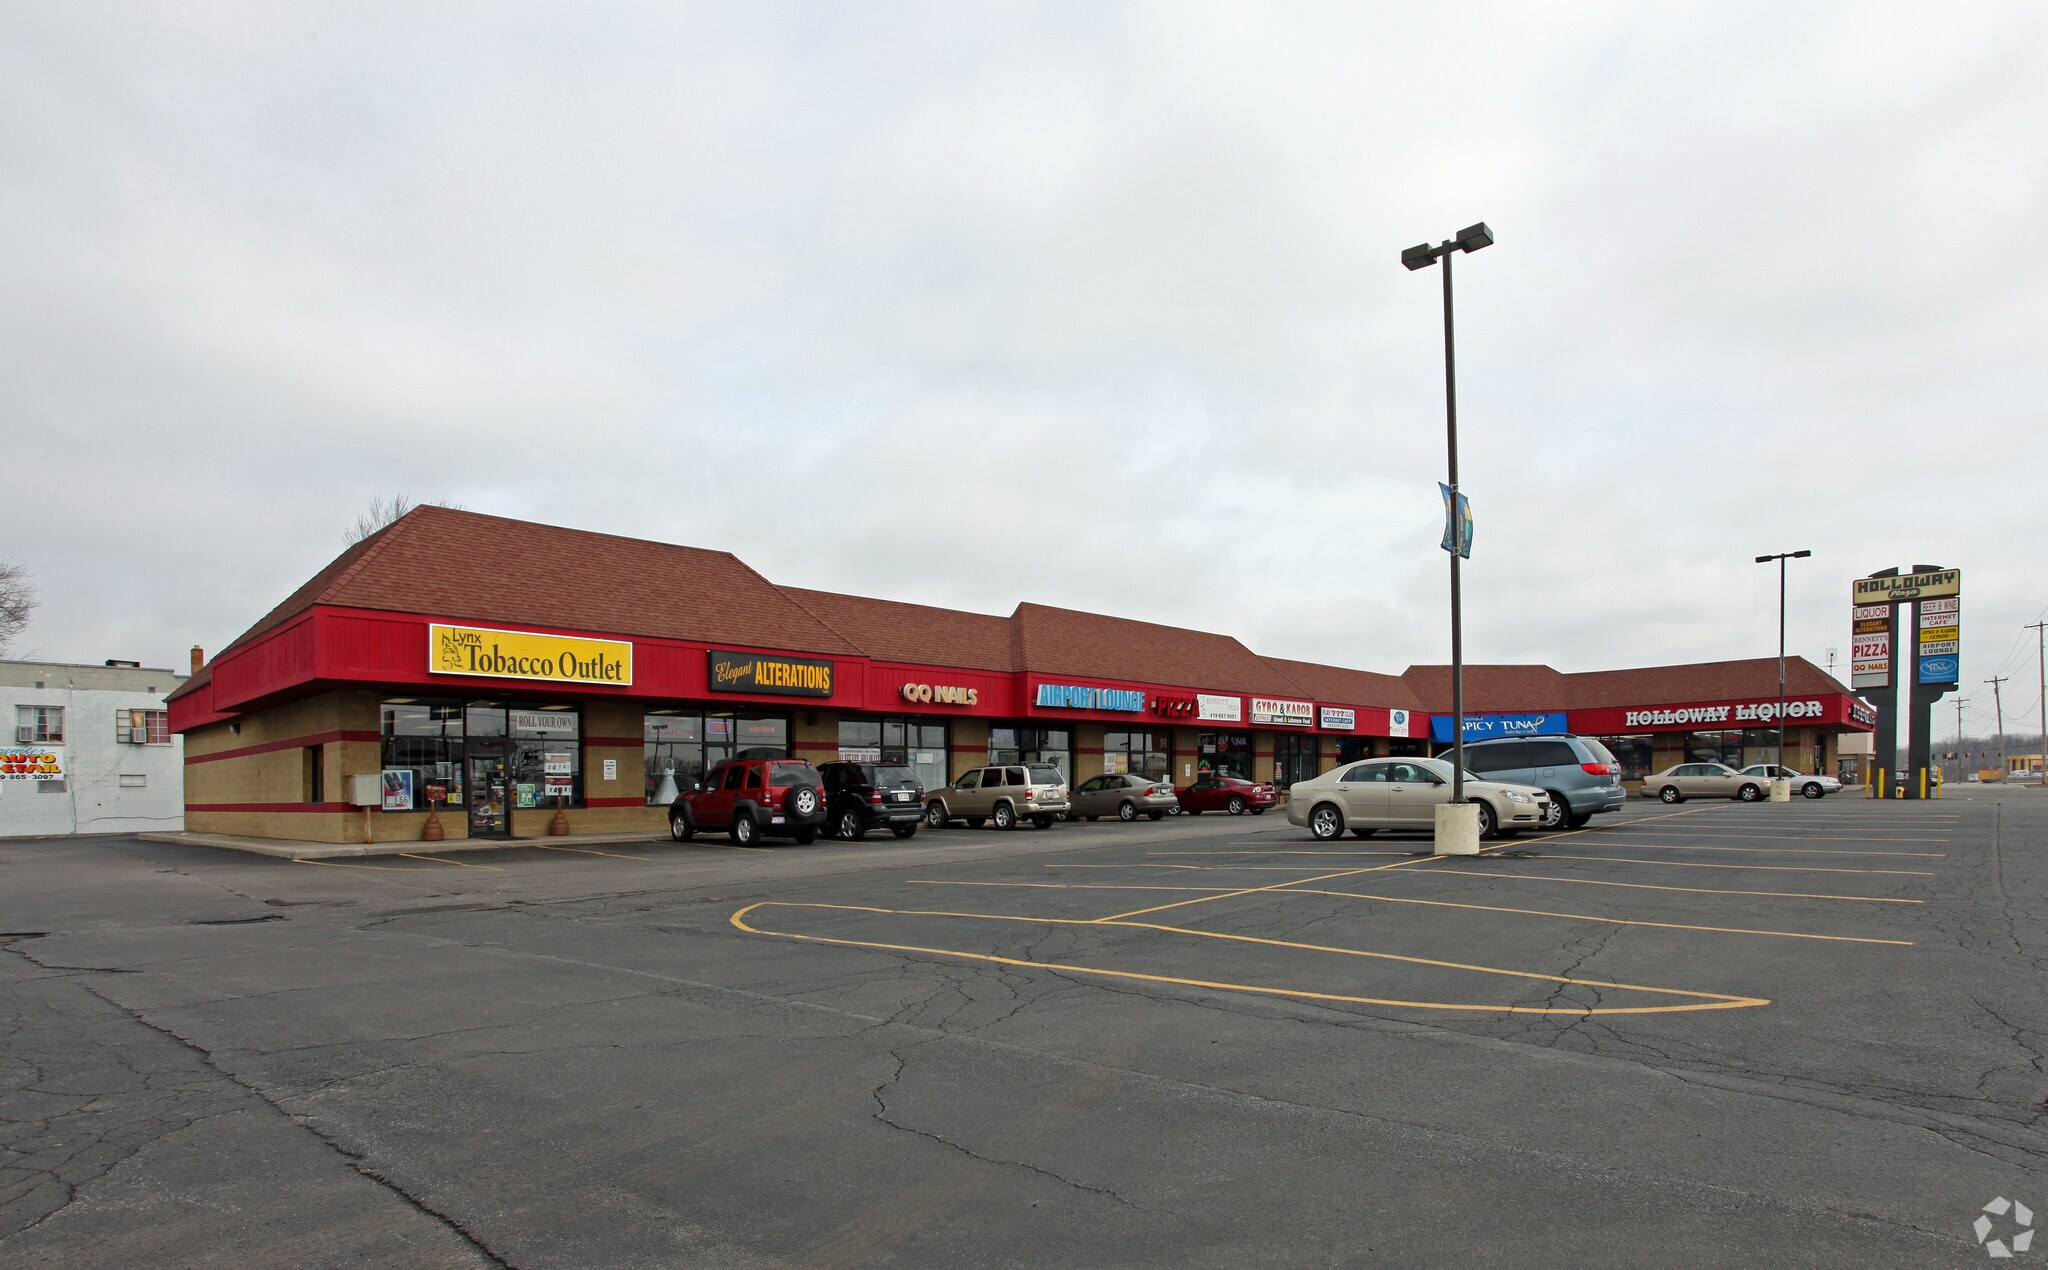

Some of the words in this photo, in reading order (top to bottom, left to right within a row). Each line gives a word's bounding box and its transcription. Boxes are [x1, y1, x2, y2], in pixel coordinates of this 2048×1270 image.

[1858, 572, 1955, 593] HOLLOWAY
[1890, 588, 1918, 597] Plaza
[1856, 607, 1887, 618] LIQUOR
[1923, 602, 1936, 612] BEER
[452, 627, 481, 646] Lynx
[1854, 635, 1888, 643] BENNETT'S
[1854, 644, 1887, 657] PIZZA
[1923, 641, 1956, 649] AIRPORT
[464, 644, 553, 676] Tobacco
[559, 651, 622, 681] Outlet
[715, 661, 753, 684] Elegant
[755, 661, 830, 689] ALTERATIONS
[903, 683, 932, 703] QQ
[934, 685, 977, 705] NAILS
[1036, 684, 1096, 709] AIRPORT
[1096, 688, 1145, 712] LOUNGE
[1156, 696, 1199, 718] PIZZA
[1256, 701, 1277, 713] GYRO
[1280, 703, 1285, 715] &
[1286, 703, 1310, 715] KABOB
[1626, 706, 1730, 726] HOLLOWAY
[1736, 701, 1822, 722] LIQUOR
[519, 715, 537, 727] ROLL
[537, 716, 556, 728] YOUR
[557, 716, 572, 728] OWN
[1500, 720, 1538, 733] TUNA
[0, 764, 62, 773] ETAIL
